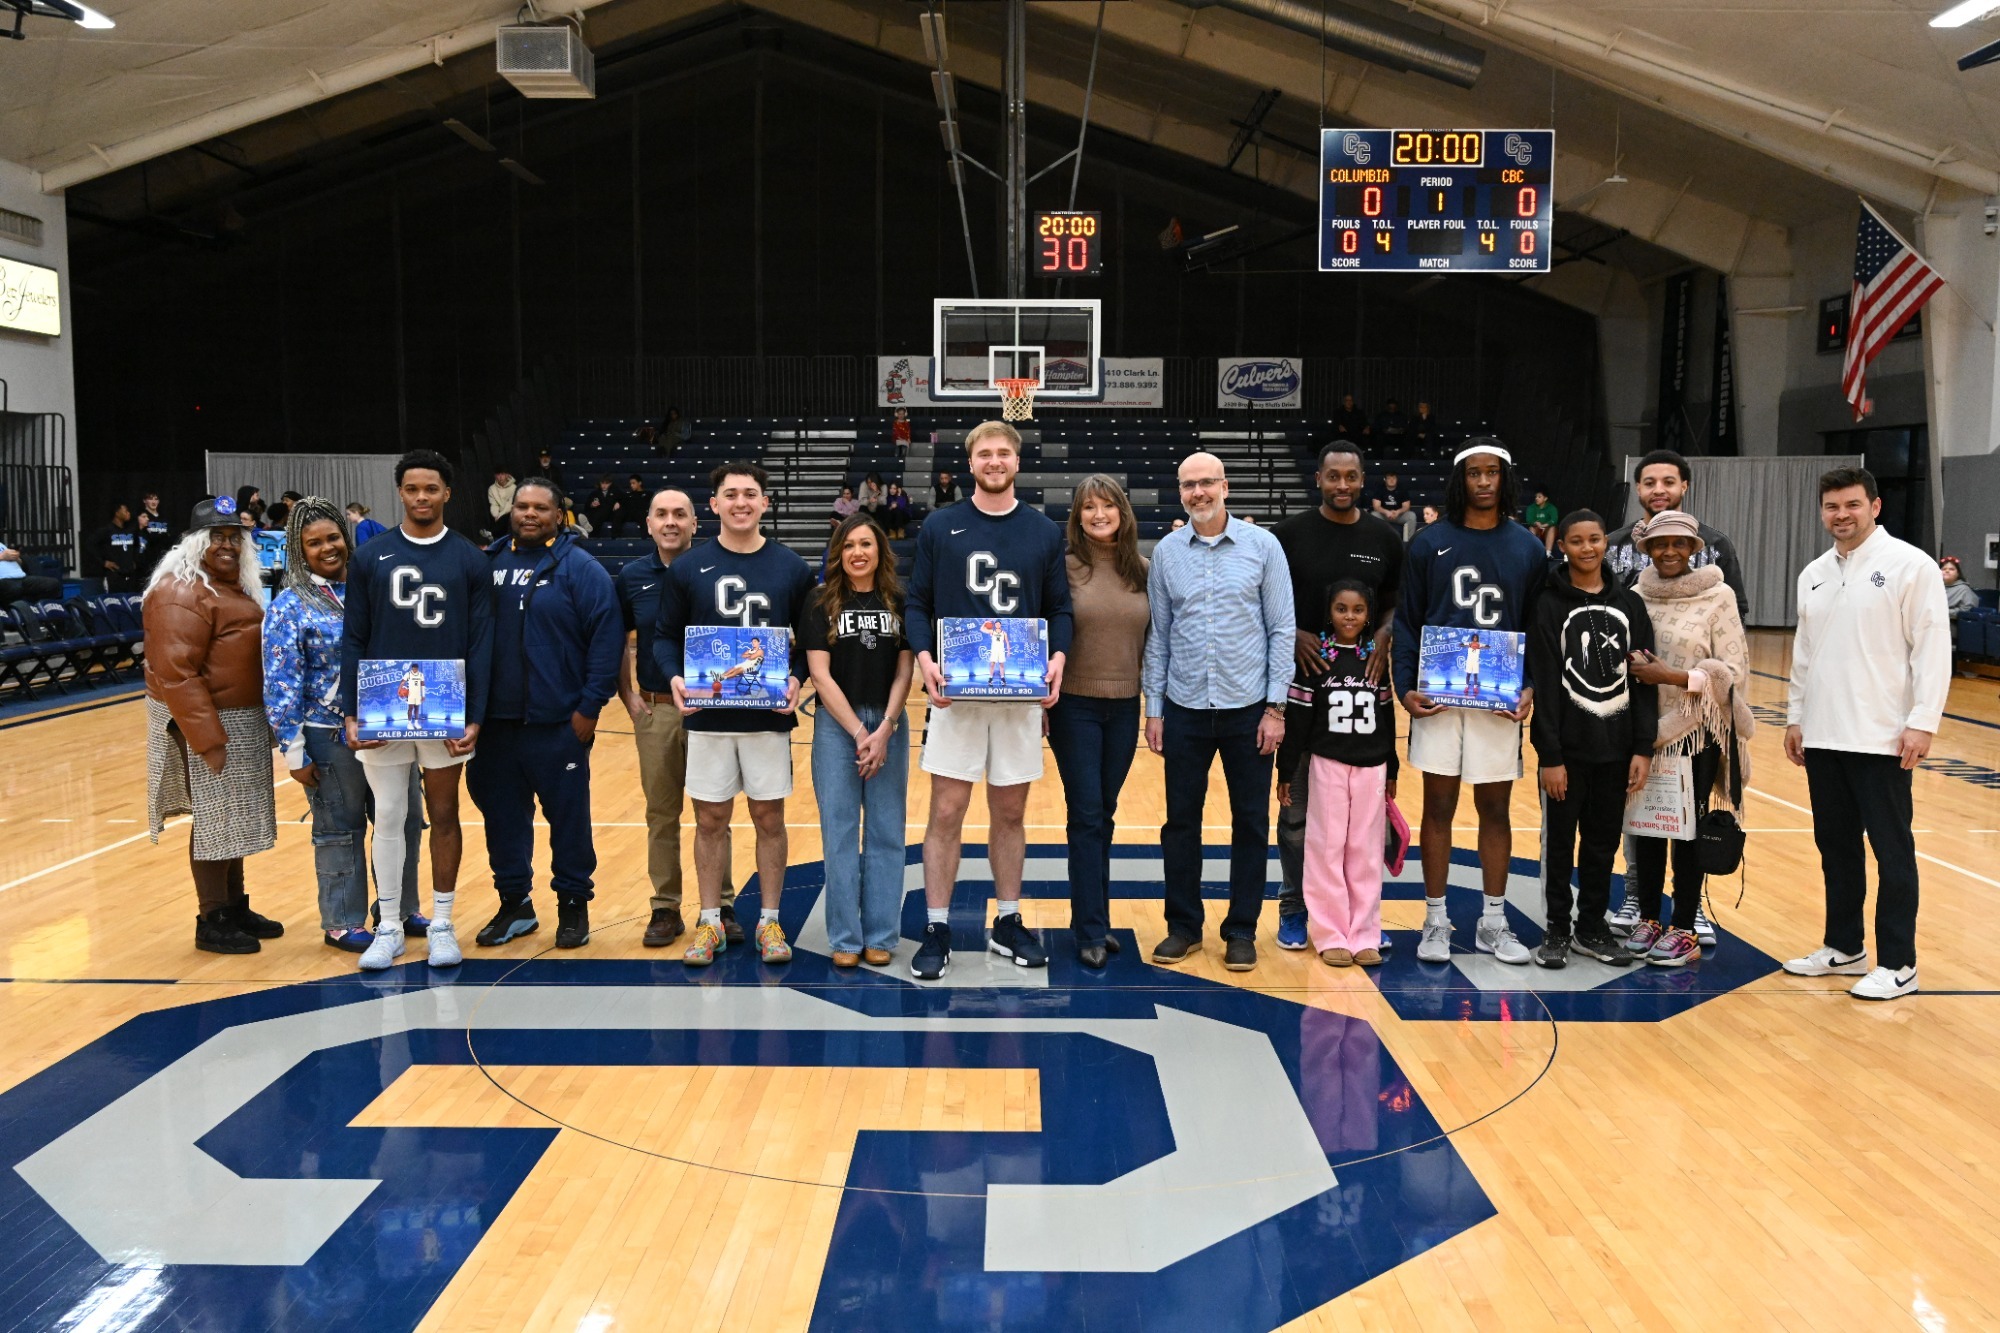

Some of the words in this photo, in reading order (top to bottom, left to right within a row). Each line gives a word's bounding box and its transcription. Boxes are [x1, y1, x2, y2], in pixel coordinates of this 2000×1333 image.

[1342, 133, 1371, 165] CC
[1396, 133, 1480, 163] 20:00
[1504, 133, 1532, 165] CC
[1330, 169, 1390, 183] COLUMBIA
[1420, 177, 1453, 187] PERIOD
[1502, 169, 1525, 183] CBC
[1363, 187, 1382, 216] 0
[1437, 191, 1443, 212] 1
[1518, 187, 1536, 217] 0
[1039, 216, 1096, 236] 20:00
[1332, 219, 1361, 230] FOULS
[1372, 219, 1395, 230] T.O.L.
[1407, 219, 1441, 230] PLAYER
[1443, 219, 1466, 230] FOUL
[1477, 219, 1500, 230] T.O.L.
[1510, 219, 1539, 230] FOULS
[1343, 230, 1358, 254] 0
[1376, 232, 1390, 252] 4
[1480, 232, 1495, 252] 4
[1520, 231, 1535, 254] 0
[1043, 237, 1087, 271] 30
[1332, 258, 1361, 268] SCORE
[1419, 258, 1450, 269] MATCH
[1509, 258, 1538, 269] SCORE
[1105, 369, 1121, 377] 410
[1123, 369, 1146, 377] Clark
[1147, 369, 1160, 377] Ln.
[1221, 359, 1294, 395] Culver's
[1718, 328, 1732, 438] Tradition
[1104, 381, 1158, 389] 73.886.9392
[966, 551, 1021, 615] CC
[1871, 571, 1886, 588] CC
[390, 565, 447, 628] CC
[714, 574, 771, 627] CC
[1452, 565, 1504, 628] CC
[858, 615, 878, 630] ARE
[711, 639, 731, 660] CC
[860, 630, 877, 650] CC
[960, 687, 985, 695] JUSTIN
[988, 687, 1013, 695] BOYER
[1018, 687, 1033, 695] #30
[1321, 675, 1343, 688] New
[1343, 675, 1365, 688] York
[715, 699, 770, 707] CARRASQUILLO
[1327, 690, 1377, 734] 23
[1461, 699, 1489, 708] GOINES
[1494, 701, 1508, 709] #21
